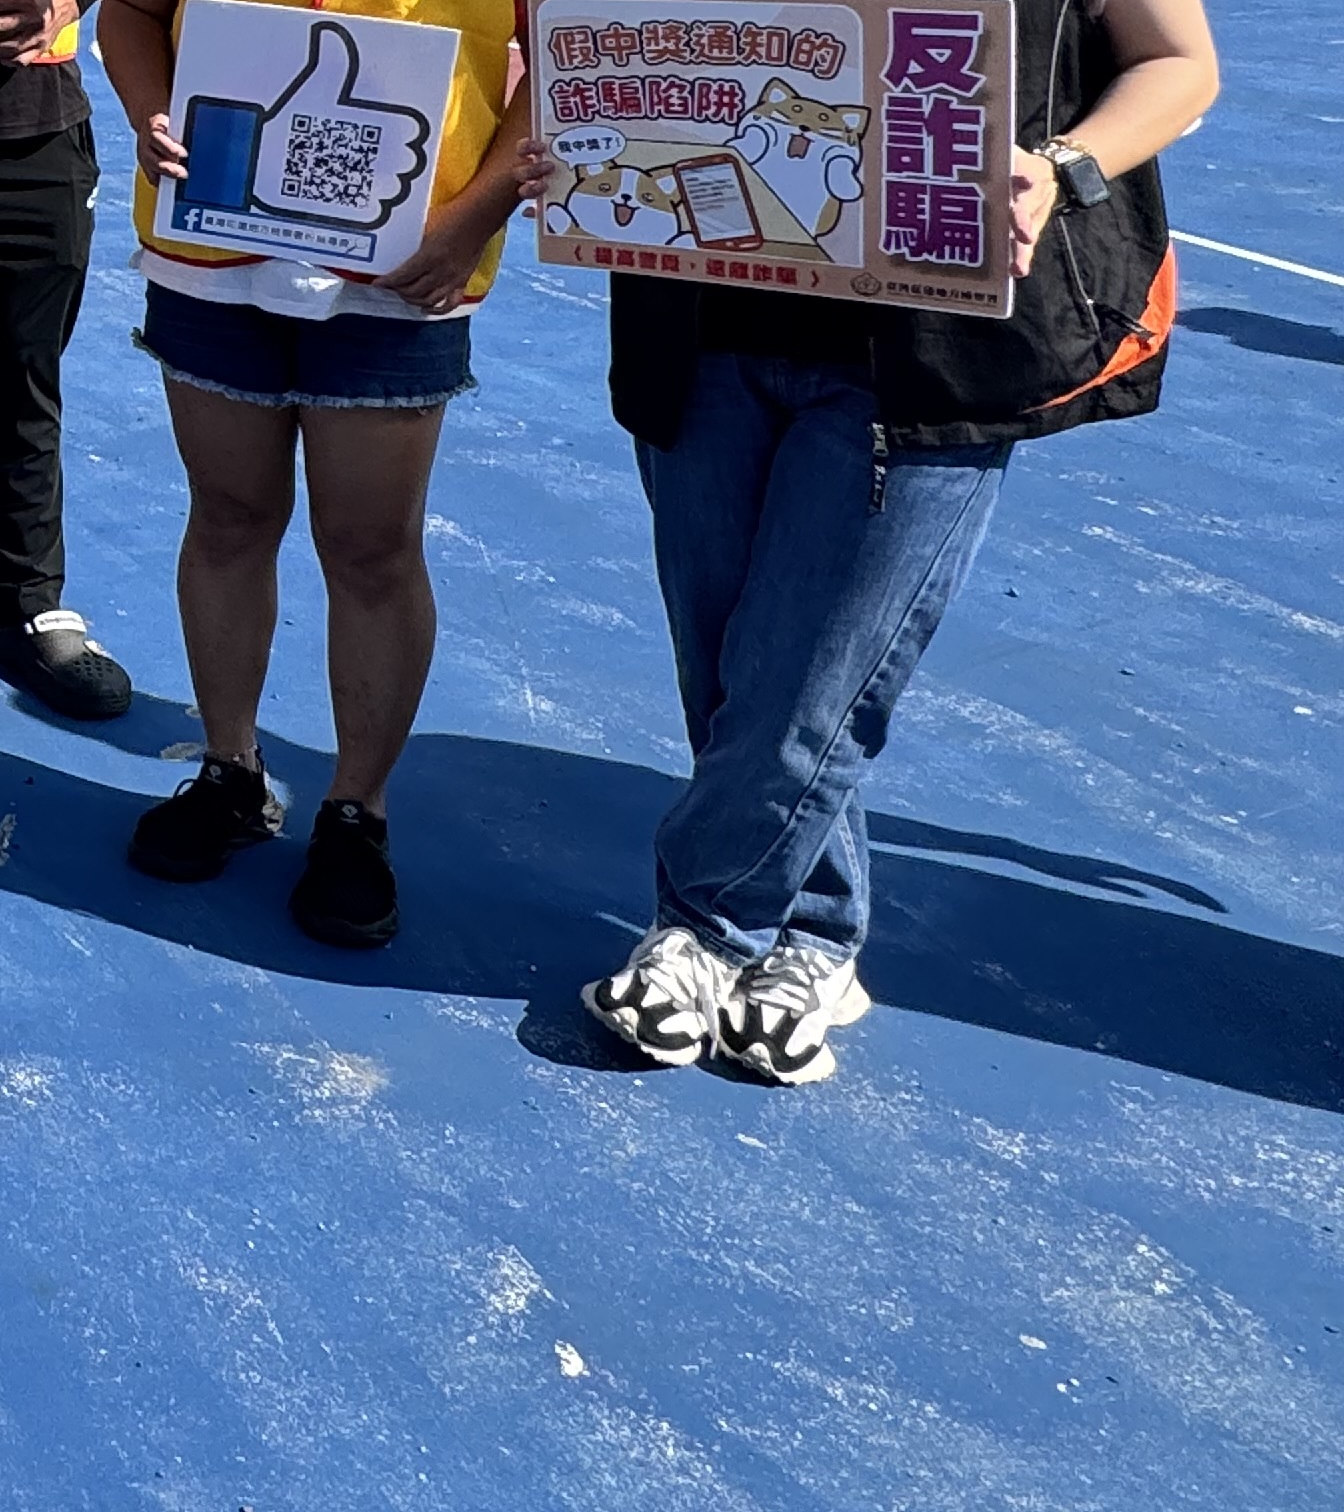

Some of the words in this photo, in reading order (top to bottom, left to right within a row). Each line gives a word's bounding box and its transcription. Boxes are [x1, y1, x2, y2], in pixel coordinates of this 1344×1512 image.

[550, 21, 846, 79] 假中獎通知的
[550, 76, 747, 124] 詐騙陷阱
[880, 8, 987, 267] 反詐騙
